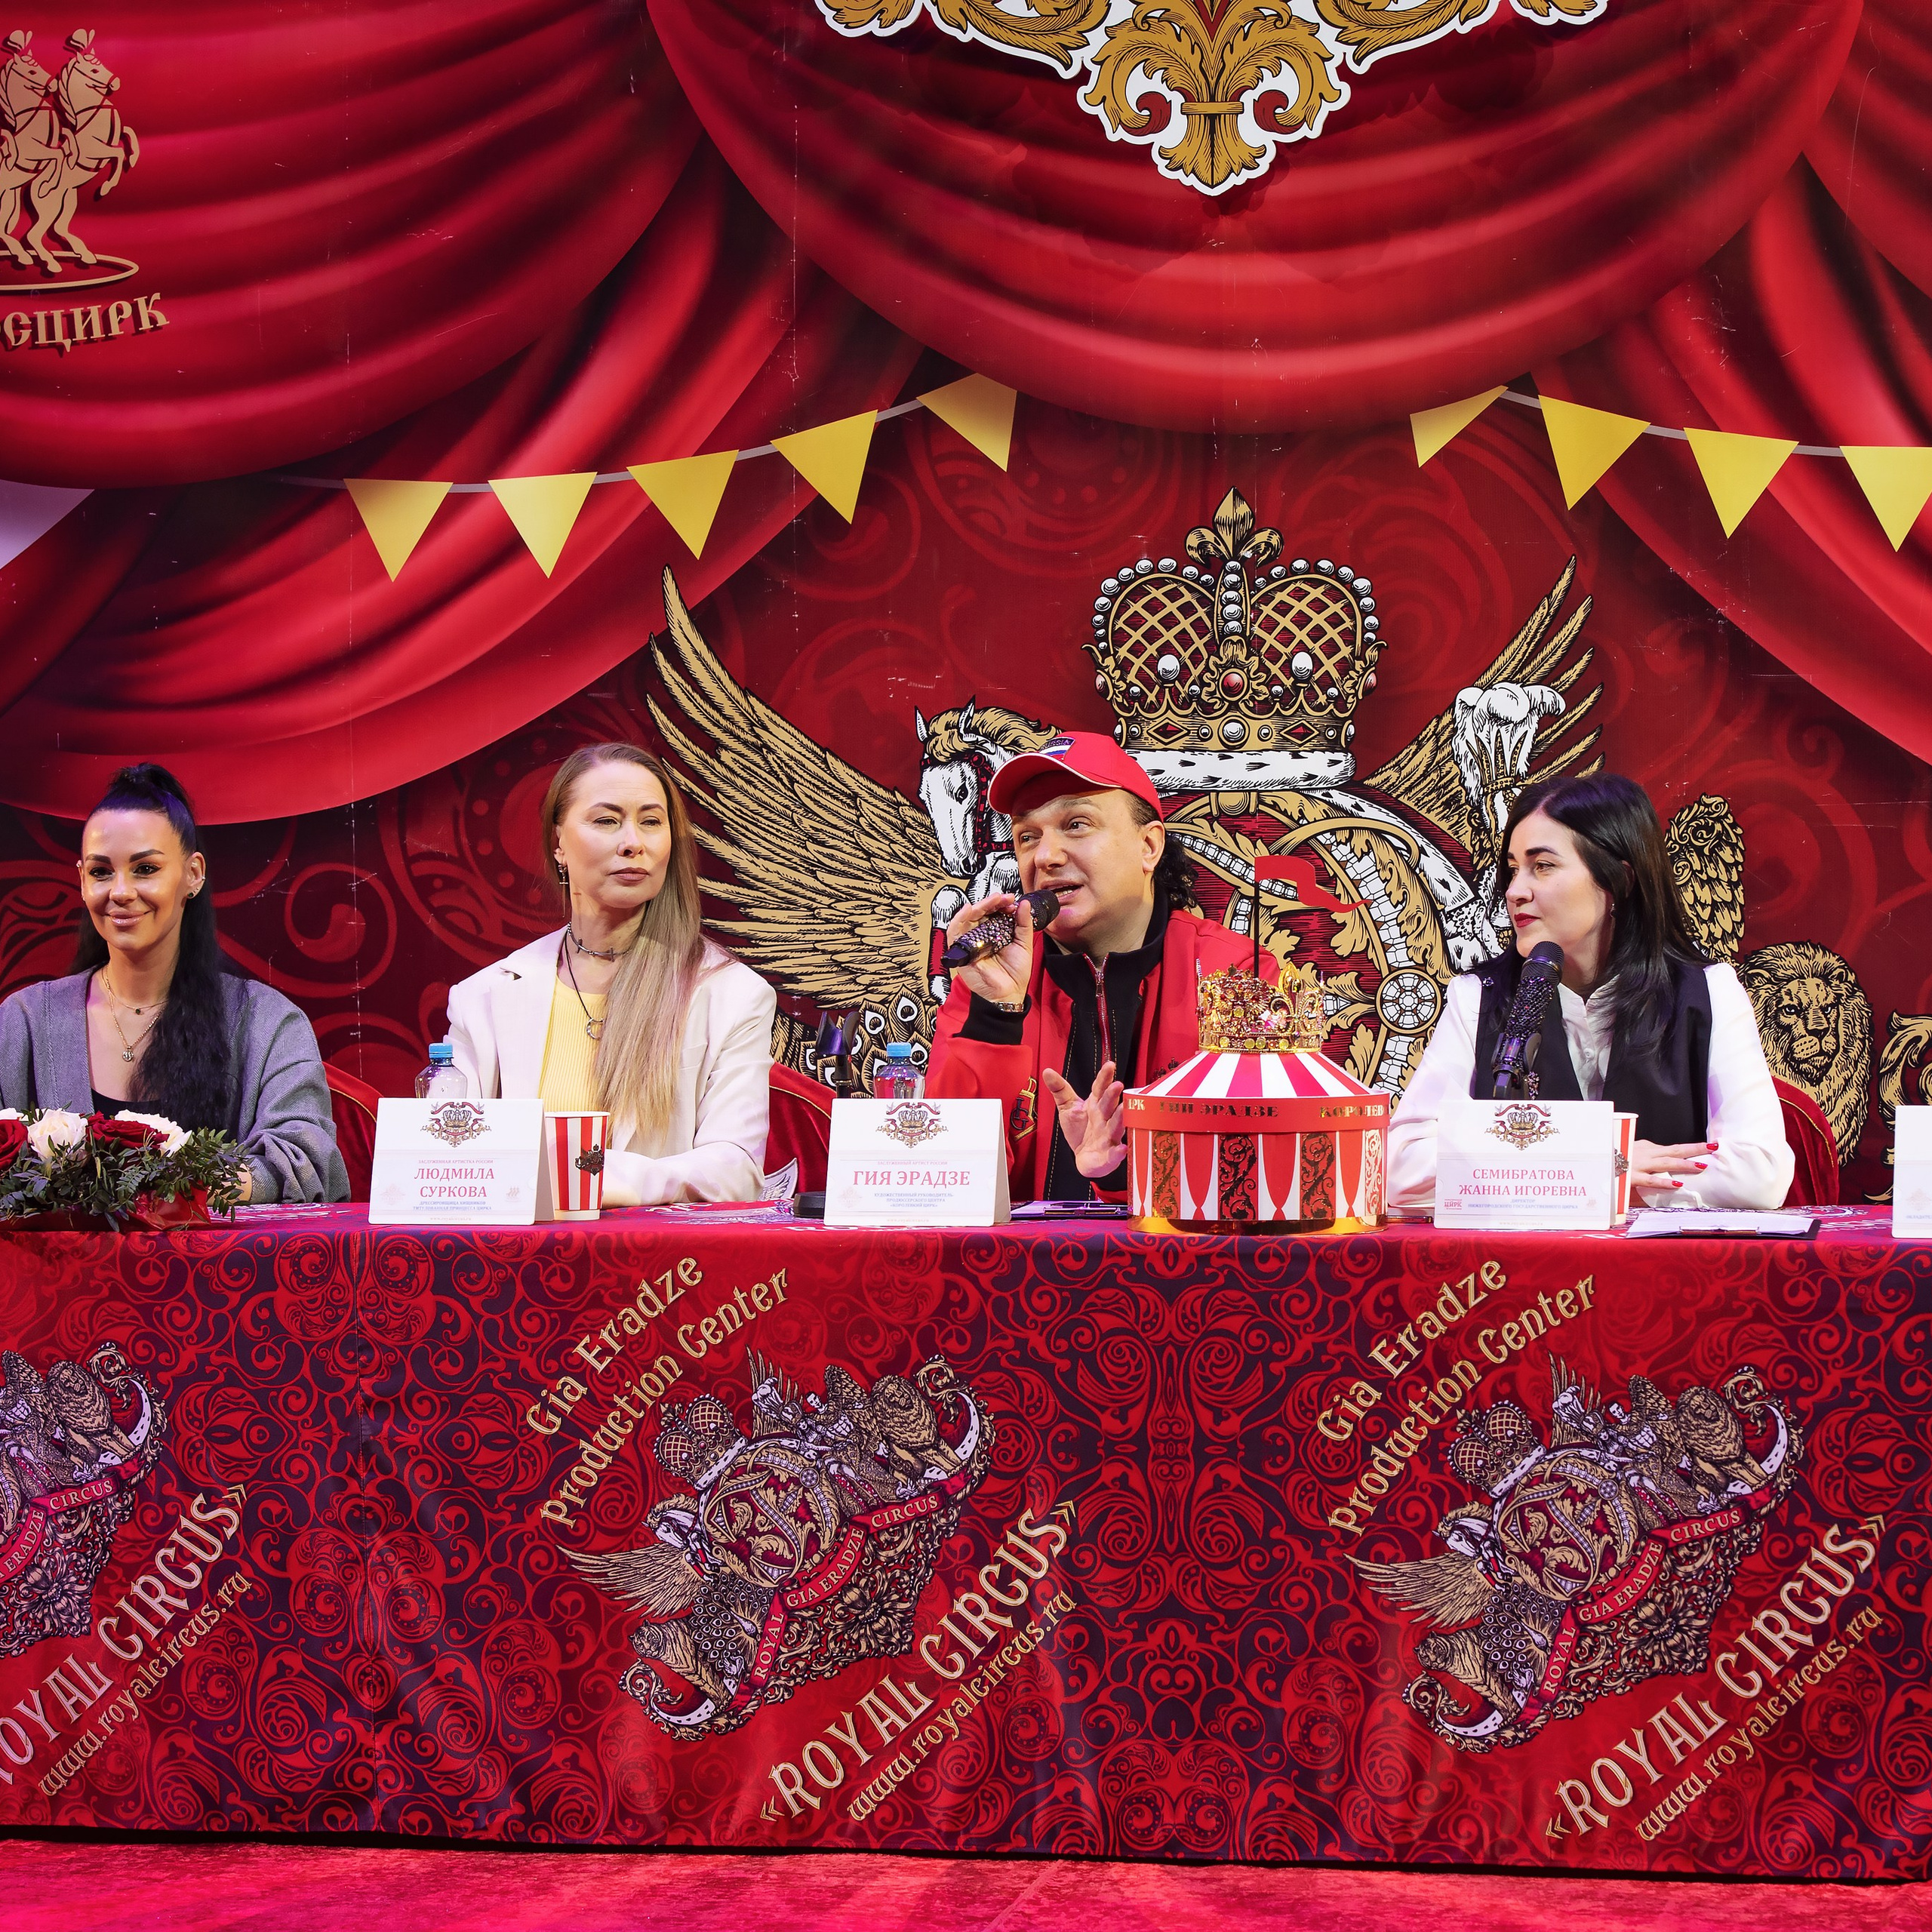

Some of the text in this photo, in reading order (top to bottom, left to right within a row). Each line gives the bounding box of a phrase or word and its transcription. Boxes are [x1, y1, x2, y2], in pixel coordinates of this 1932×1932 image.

[0, 293, 170, 352] СЦИРК
[414, 1168, 495, 1181] ЛЮДМИЛА
[420, 1186, 488, 1198] СУРКОВА
[853, 1171, 971, 1189] ГИЯ ЭРАДЗЕ
[1200, 1103, 1278, 1118] ЭРАДЗЕ
[1459, 1185, 1587, 1196] ЖАННА ИГОРЕВНА
[1472, 1168, 1575, 1180] СЕМИБРАТОВА
[527, 1257, 703, 1435] Gia Eradze
[540, 1268, 789, 1529] Production Center
[1316, 1260, 1506, 1441] Gia Eradze
[1327, 1274, 1595, 1537] Production Center
[4, 1480, 114, 1573] ERADZE CIRCUS
[97, 1484, 248, 1660] CIRCUS»
[754, 1494, 939, 1680] ROYAL GIA ERADZE CIRCUS
[1543, 1510, 1742, 1695] ROYAL GIA ERADZE CIRCUS
[38, 1571, 253, 1797] www.royalcircus.ru
[760, 1500, 1078, 1822] «ROYAL CIRCUS»
[846, 1589, 1078, 1822] www.royalcircus.ru
[1545, 1515, 1886, 1840] «ROYAL CIRCUS»
[1635, 1605, 1884, 1841] www.royalcircus.ru
